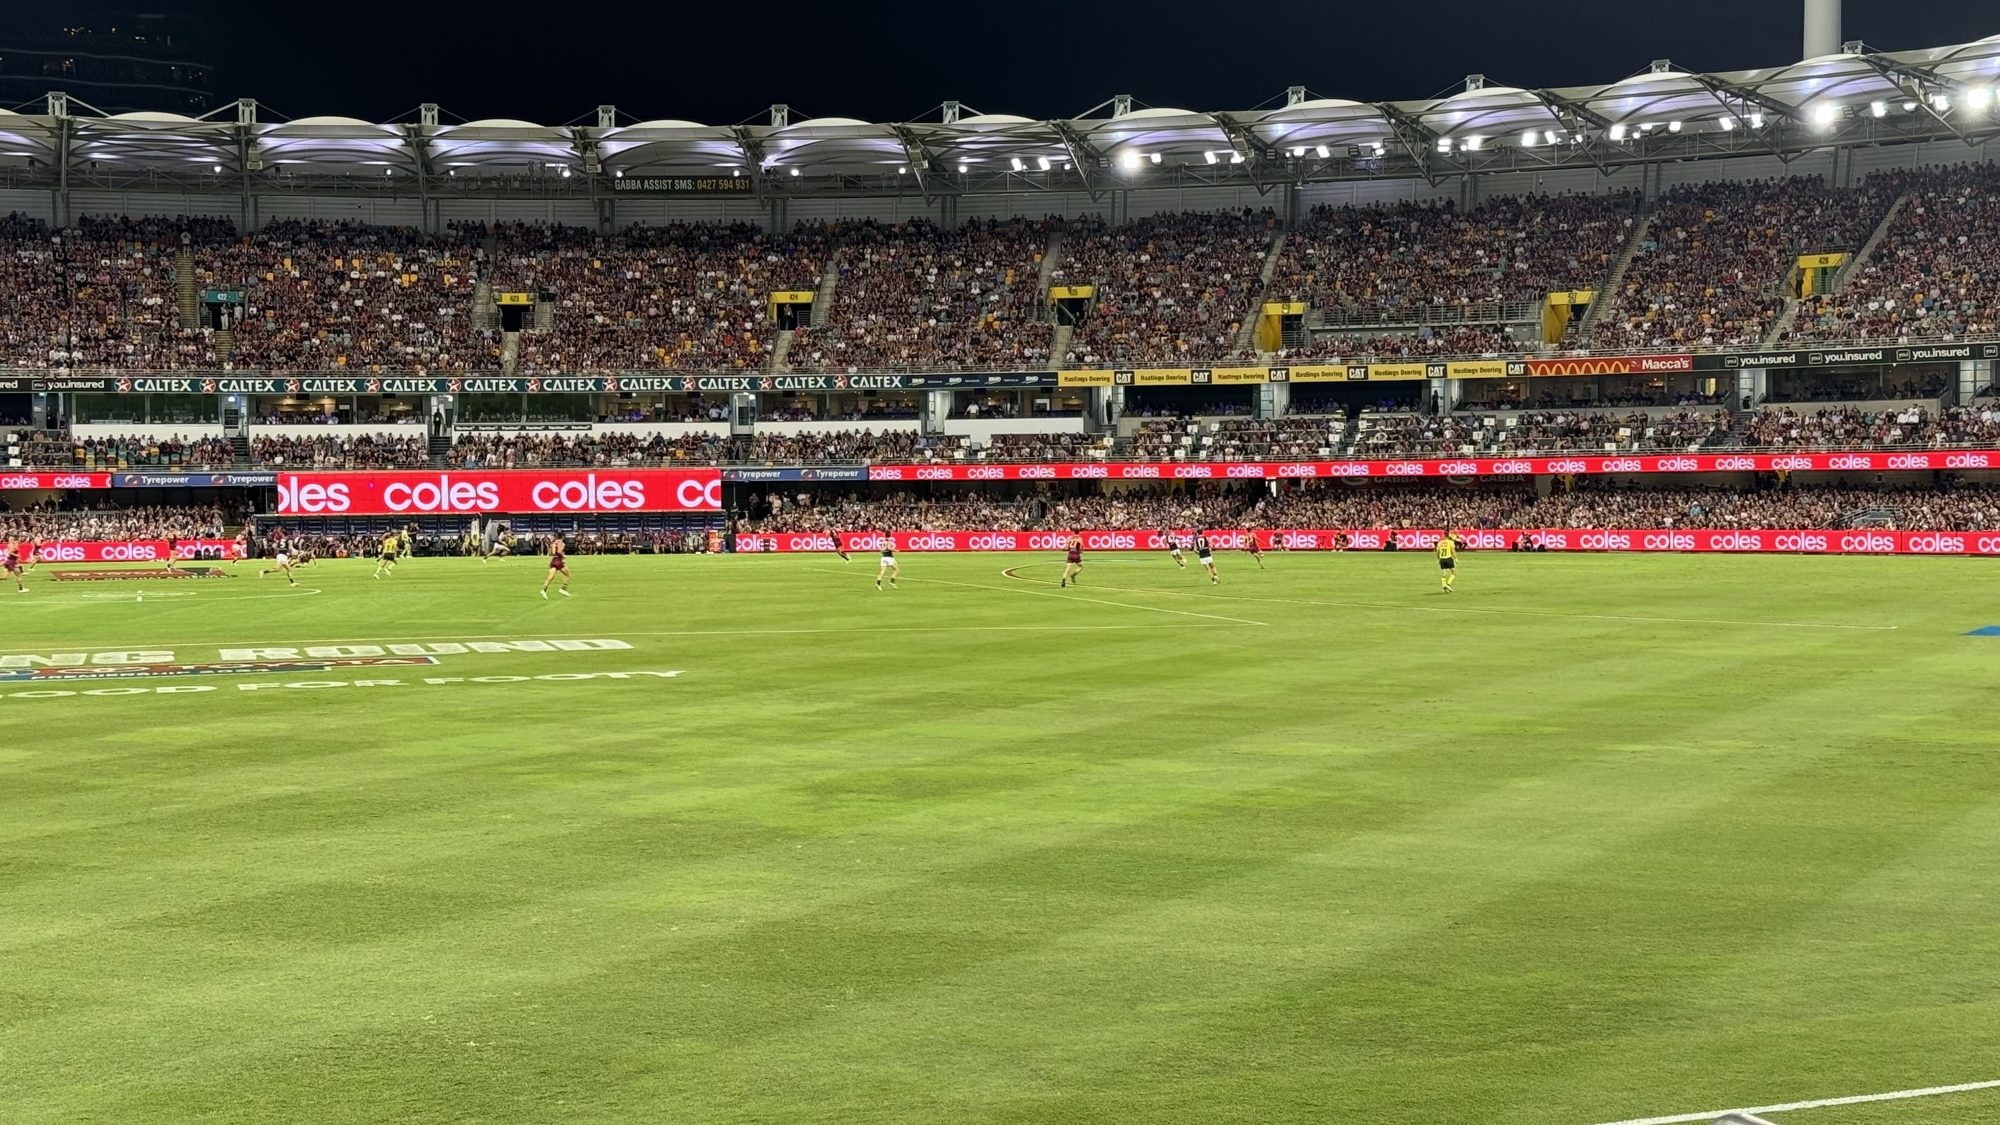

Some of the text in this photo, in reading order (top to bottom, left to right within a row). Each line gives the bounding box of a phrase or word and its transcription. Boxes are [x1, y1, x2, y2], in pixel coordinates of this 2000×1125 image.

[615, 180, 750, 190] GABBA ASSIST SMS: 0427 594 931
[1824, 350, 1883, 364] you.insured
[1912, 346, 1970, 359] you.insured
[1740, 353, 1796, 367] you.insured
[1271, 370, 1286, 381] CAT
[1348, 368, 1365, 379] CAT
[1428, 366, 1444, 377] CAT
[1508, 363, 1526, 375] CAT
[774, 377, 827, 389] CALTEX
[850, 376, 903, 388] CALTEX
[1116, 373, 1131, 383] CAT
[1193, 372, 1208, 382] CAT
[134, 379, 192, 392] CALTEX
[219, 379, 276, 392] CALTEX
[303, 379, 358, 392] CALTEX
[383, 379, 438, 392] CALTEX
[464, 379, 519, 391] CALTEX
[543, 379, 597, 391] CALTEX
[620, 378, 673, 390] CALTEX
[698, 378, 751, 390] CALTEX
[1493, 459, 1532, 474] coles
[1548, 458, 1586, 473] coles
[1602, 457, 1642, 472] coles
[1658, 456, 1698, 471] coles
[1716, 455, 1755, 471] coles
[1772, 454, 1812, 470] coles
[1829, 454, 1871, 469] coles
[1888, 453, 1929, 468] coles
[1946, 452, 1989, 468] coles
[815, 469, 860, 479] Tyrepower
[917, 466, 953, 479] coles
[968, 465, 1004, 478] coles
[1019, 465, 1057, 478] coles
[1072, 465, 1108, 478] coles
[1123, 464, 1160, 477] coles
[1175, 464, 1212, 477] coles
[1227, 464, 1264, 477] coles
[1279, 463, 1316, 476] coles
[1332, 462, 1370, 476] coles
[1386, 461, 1424, 475] coles
[1439, 460, 1477, 475] coles
[54, 474, 91, 487] coles
[141, 475, 190, 485] Tyrepower
[227, 475, 274, 484] Tyrepower
[737, 470, 781, 479] Tyrepower
[2, 475, 39, 488] coles
[384, 475, 500, 511] coles
[532, 474, 646, 509] coles
[909, 534, 956, 550] coles
[969, 533, 1016, 549] coles
[1088, 532, 1136, 549] coles
[1580, 531, 1631, 549] coles
[1644, 531, 1696, 549] coles
[1711, 532, 1762, 549] coles
[1776, 532, 1828, 550] coles
[1841, 533, 1895, 551] coles
[1909, 533, 1965, 552] coles
[102, 544, 157, 559] coles
[1440, 548, 1448, 557] 21
[219, 638, 635, 662] ROUND
[237, 679, 410, 691] FOR
[423, 670, 688, 686] FOOTY
